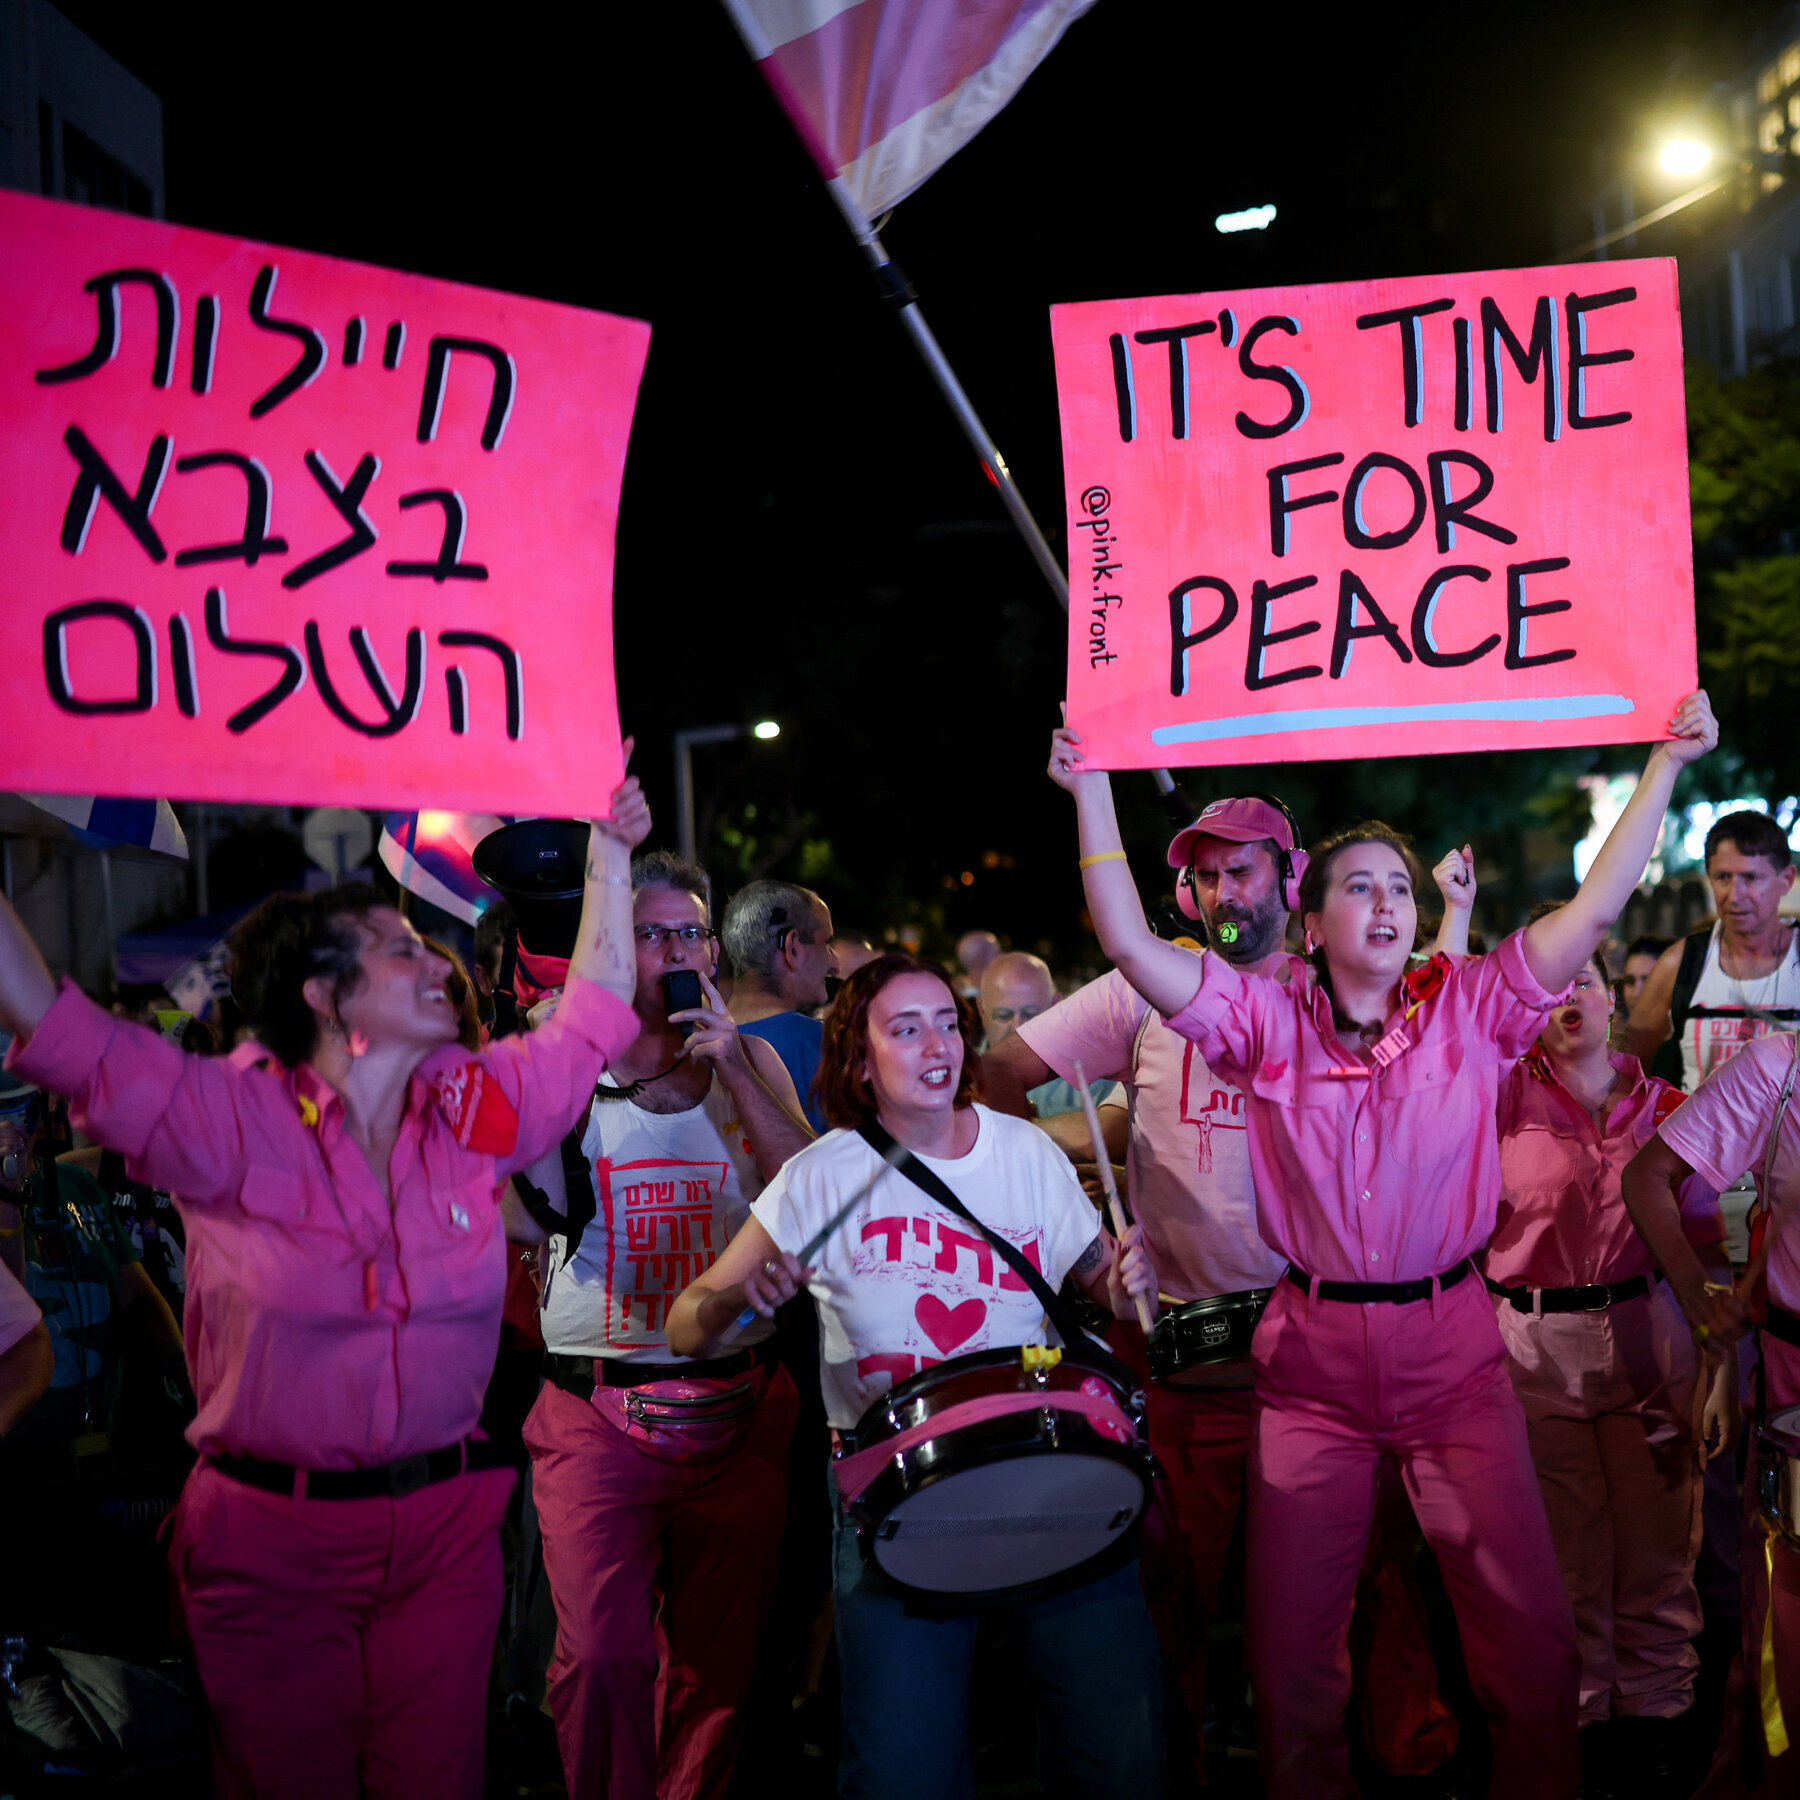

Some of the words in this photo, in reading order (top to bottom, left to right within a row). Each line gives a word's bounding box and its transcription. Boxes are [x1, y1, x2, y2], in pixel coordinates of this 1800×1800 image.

[35, 265, 516, 451] חיילות
[1109, 309, 1310, 442] IT'S
[1356, 287, 1636, 442] TIME
[61, 425, 488, 589] בצבא
[1076, 485, 1123, 669] @pink.front
[1267, 450, 1517, 556] FOR
[43, 587, 523, 740] השלום
[1168, 557, 1577, 696] PEACE
[624, 1181, 675, 1206] שלם
[626, 1213, 713, 1252] דורש
